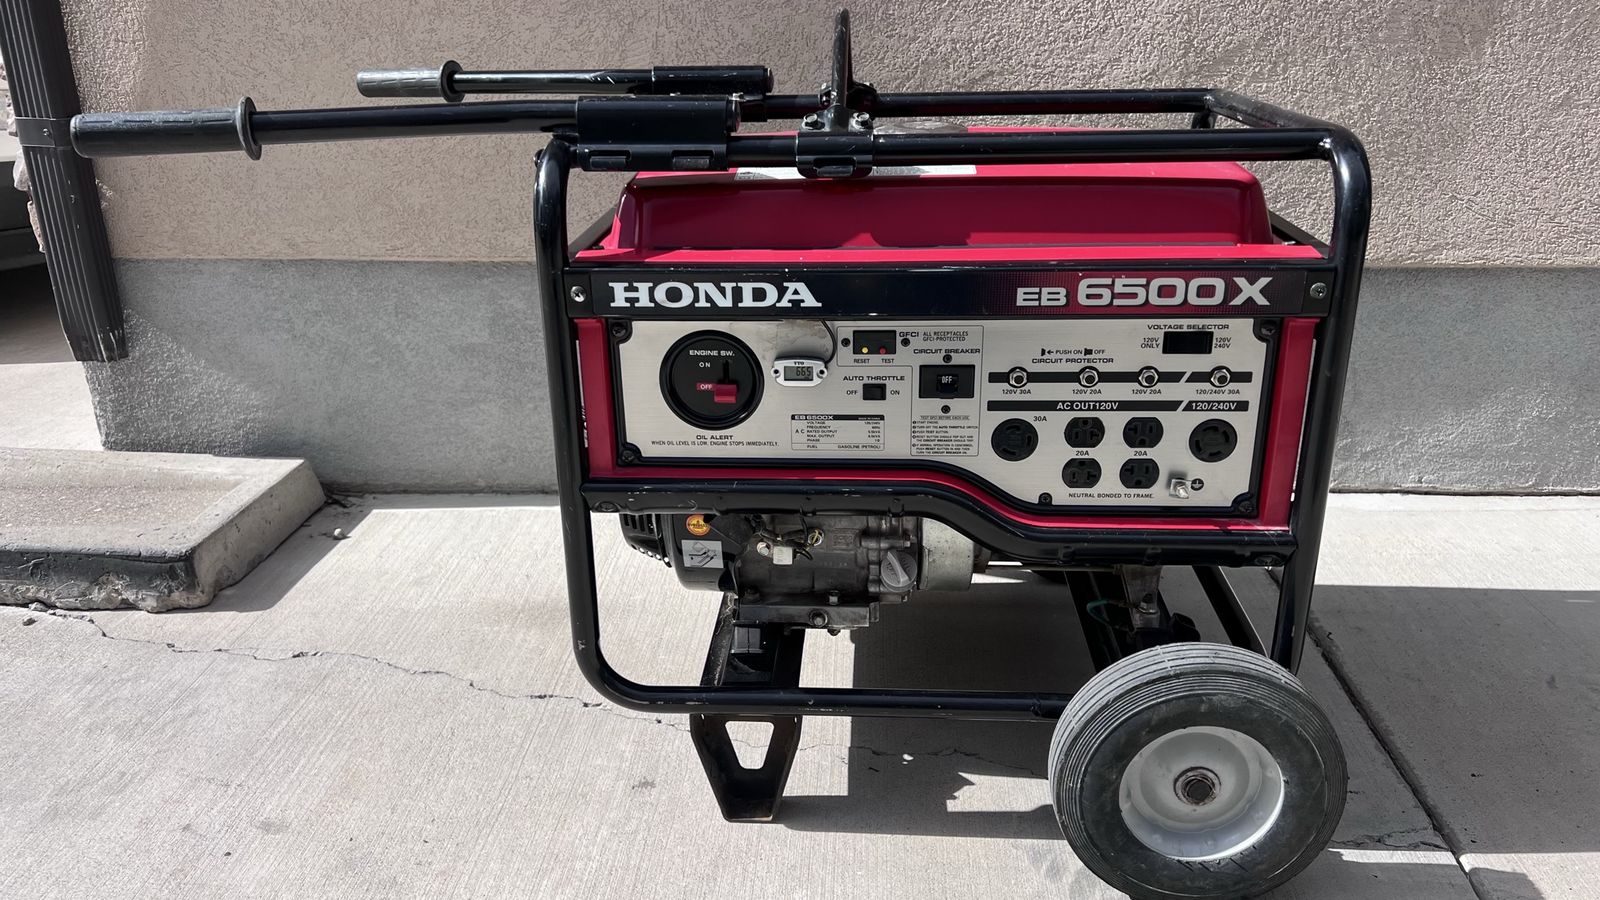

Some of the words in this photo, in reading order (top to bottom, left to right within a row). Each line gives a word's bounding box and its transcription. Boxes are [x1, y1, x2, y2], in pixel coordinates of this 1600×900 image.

[608, 282, 822, 308] HONDA
[1016, 287, 1067, 306] EB
[796, 367, 811, 376] 665
